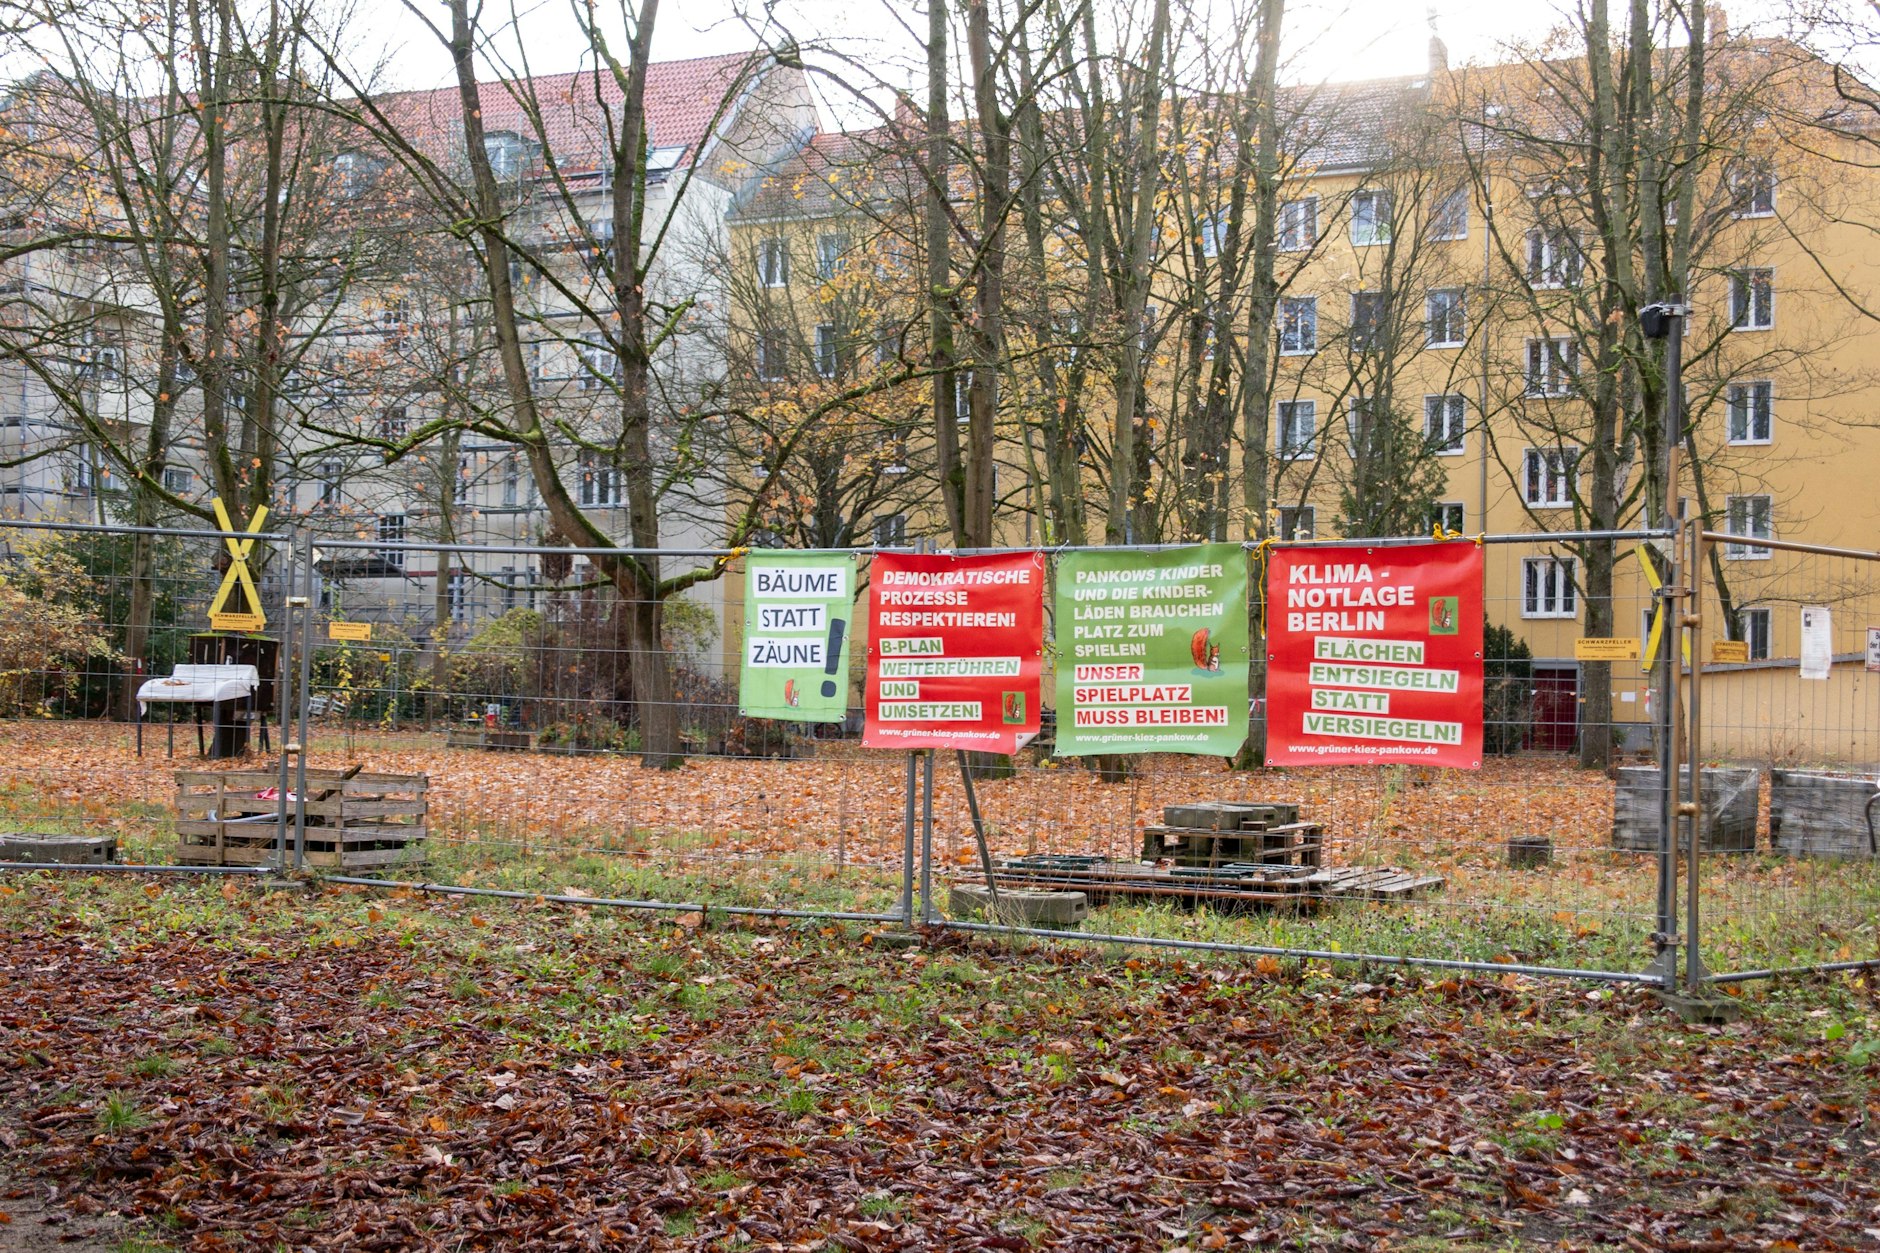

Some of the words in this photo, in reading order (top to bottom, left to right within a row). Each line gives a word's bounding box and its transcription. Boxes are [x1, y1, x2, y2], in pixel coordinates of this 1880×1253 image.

[758, 570, 837, 592] BÄUME
[883, 570, 1029, 586] DEMOKRATISCHE
[1076, 568, 1155, 584] PANKOWS
[1160, 564, 1223, 580] KINDER
[1289, 564, 1371, 584] KLIMA
[880, 591, 967, 605] PROZESSE
[1074, 587, 1108, 601] UND
[1112, 586, 1140, 600] DIE
[1143, 584, 1212, 599] KINDER-
[1288, 586, 1414, 608] NOTLAGE
[762, 608, 820, 628] STATT
[880, 612, 1015, 627] RESPEKTIEREN!
[1074, 604, 1125, 620] LÄDEN
[1129, 603, 1223, 619] BRAUCHEN
[1288, 611, 1384, 632] BERLIN
[1074, 625, 1123, 639] PLATZ
[1127, 624, 1163, 637] ZUM
[753, 641, 820, 664] ZÄUNE
[882, 639, 940, 654] B-PLAN
[1074, 644, 1146, 657] SPIELEN!
[1318, 639, 1422, 663] FLÄCHEN
[882, 659, 1018, 675] WEITERFÜHREN
[1077, 666, 1140, 680] UNSER
[1313, 667, 1456, 690] ENTSIEGELN
[882, 683, 916, 697] UND
[1076, 687, 1189, 702] SPIELPLATZ
[1315, 692, 1386, 710] STATT
[881, 703, 980, 719] UMSETZEN!
[1076, 710, 1129, 725] MUSS
[1135, 709, 1225, 725] BLEIBEN!
[879, 728, 1000, 740] www.grüner-kiez-pankow.de
[1307, 715, 1457, 741] VERSIEGELN!
[1076, 733, 1209, 743] www.grüner-kiez-pankow.de
[1289, 745, 1438, 755] www.grüner-kiez-pankow.de
